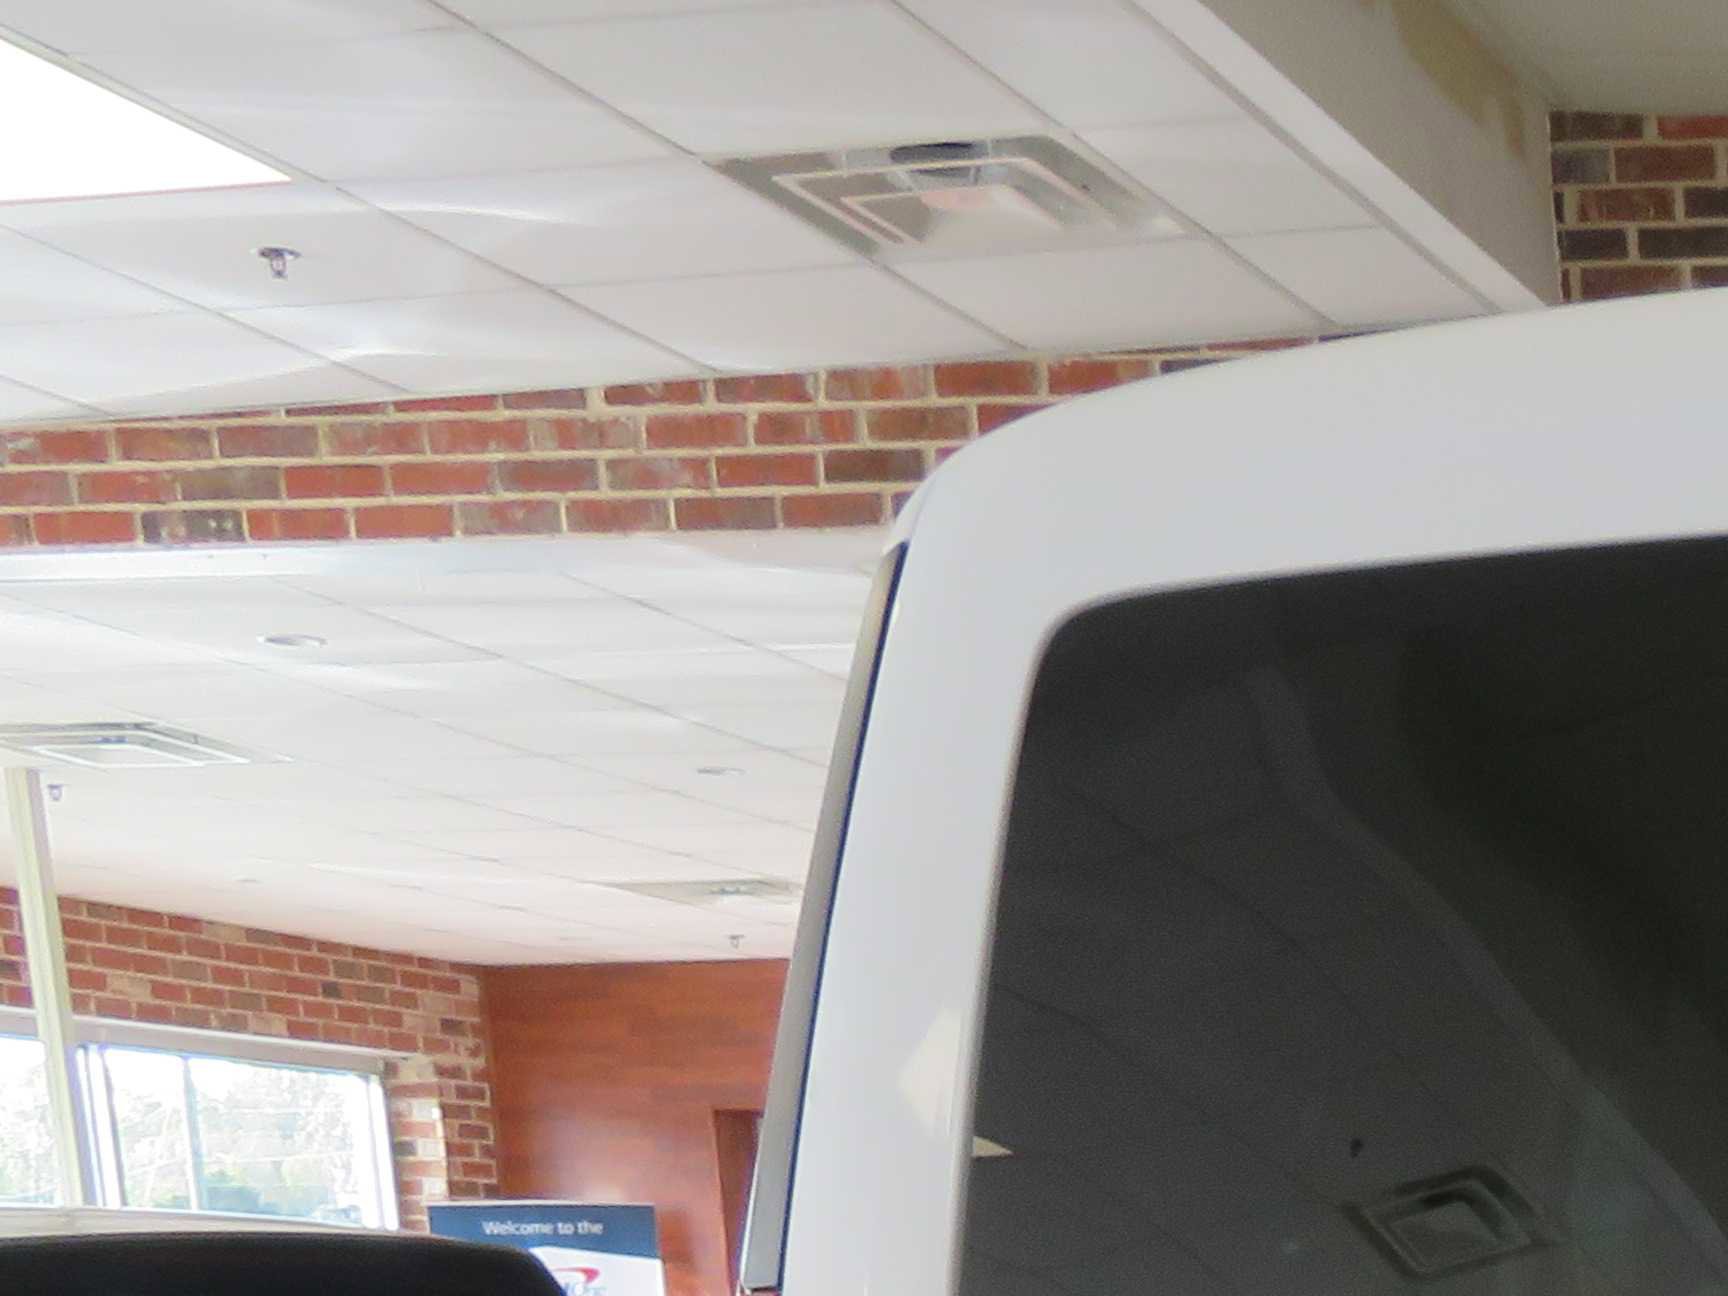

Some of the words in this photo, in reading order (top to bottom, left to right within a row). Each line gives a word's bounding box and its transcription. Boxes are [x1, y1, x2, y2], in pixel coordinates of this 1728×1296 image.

[481, 1220, 554, 1236] Welcome
[557, 1221, 575, 1236] to
[577, 1220, 604, 1236] the
